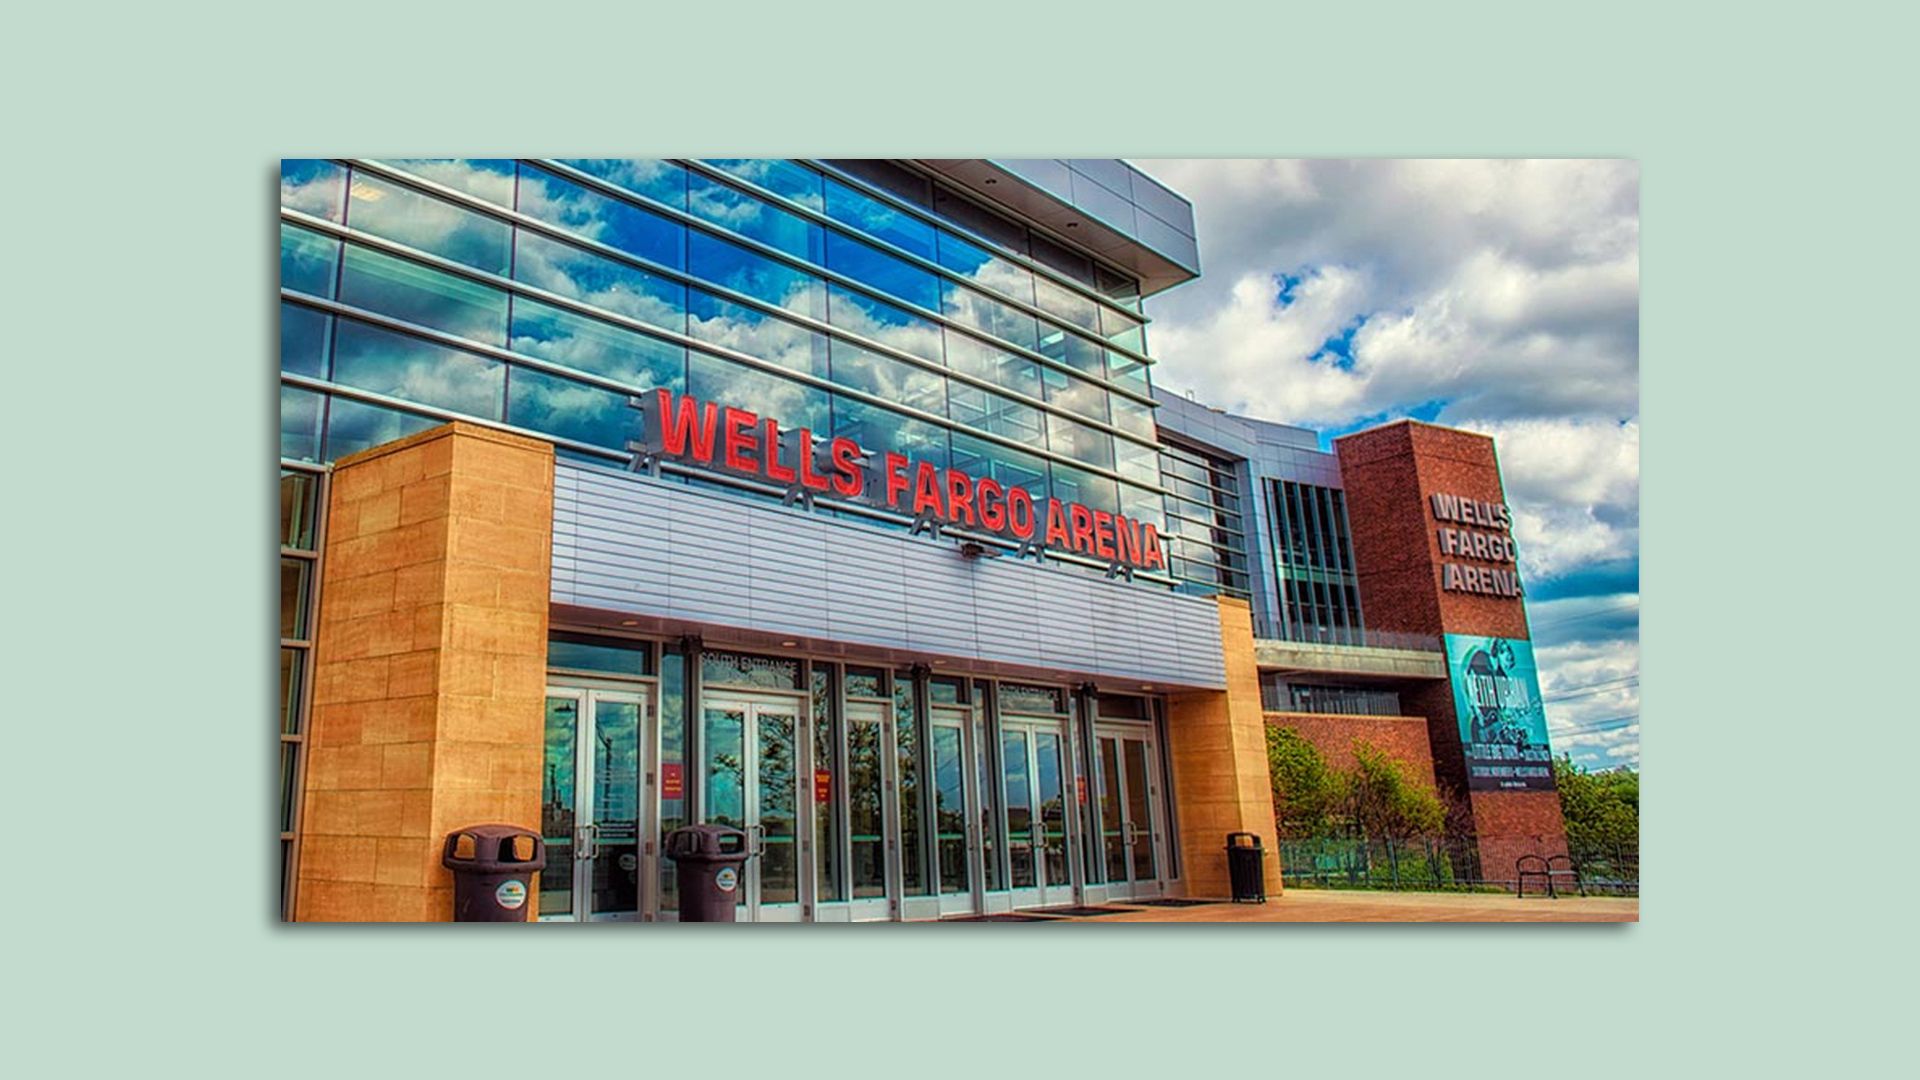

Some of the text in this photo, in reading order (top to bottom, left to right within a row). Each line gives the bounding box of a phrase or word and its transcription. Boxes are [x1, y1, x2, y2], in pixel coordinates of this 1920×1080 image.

[657, 388, 1166, 570] WELLS FARGO ARENA
[1431, 492, 1509, 530] WELLS
[1439, 527, 1516, 563] FARGO
[1444, 562, 1522, 597] ARENA
[701, 652, 798, 679] SOUTH ENTRANCE
